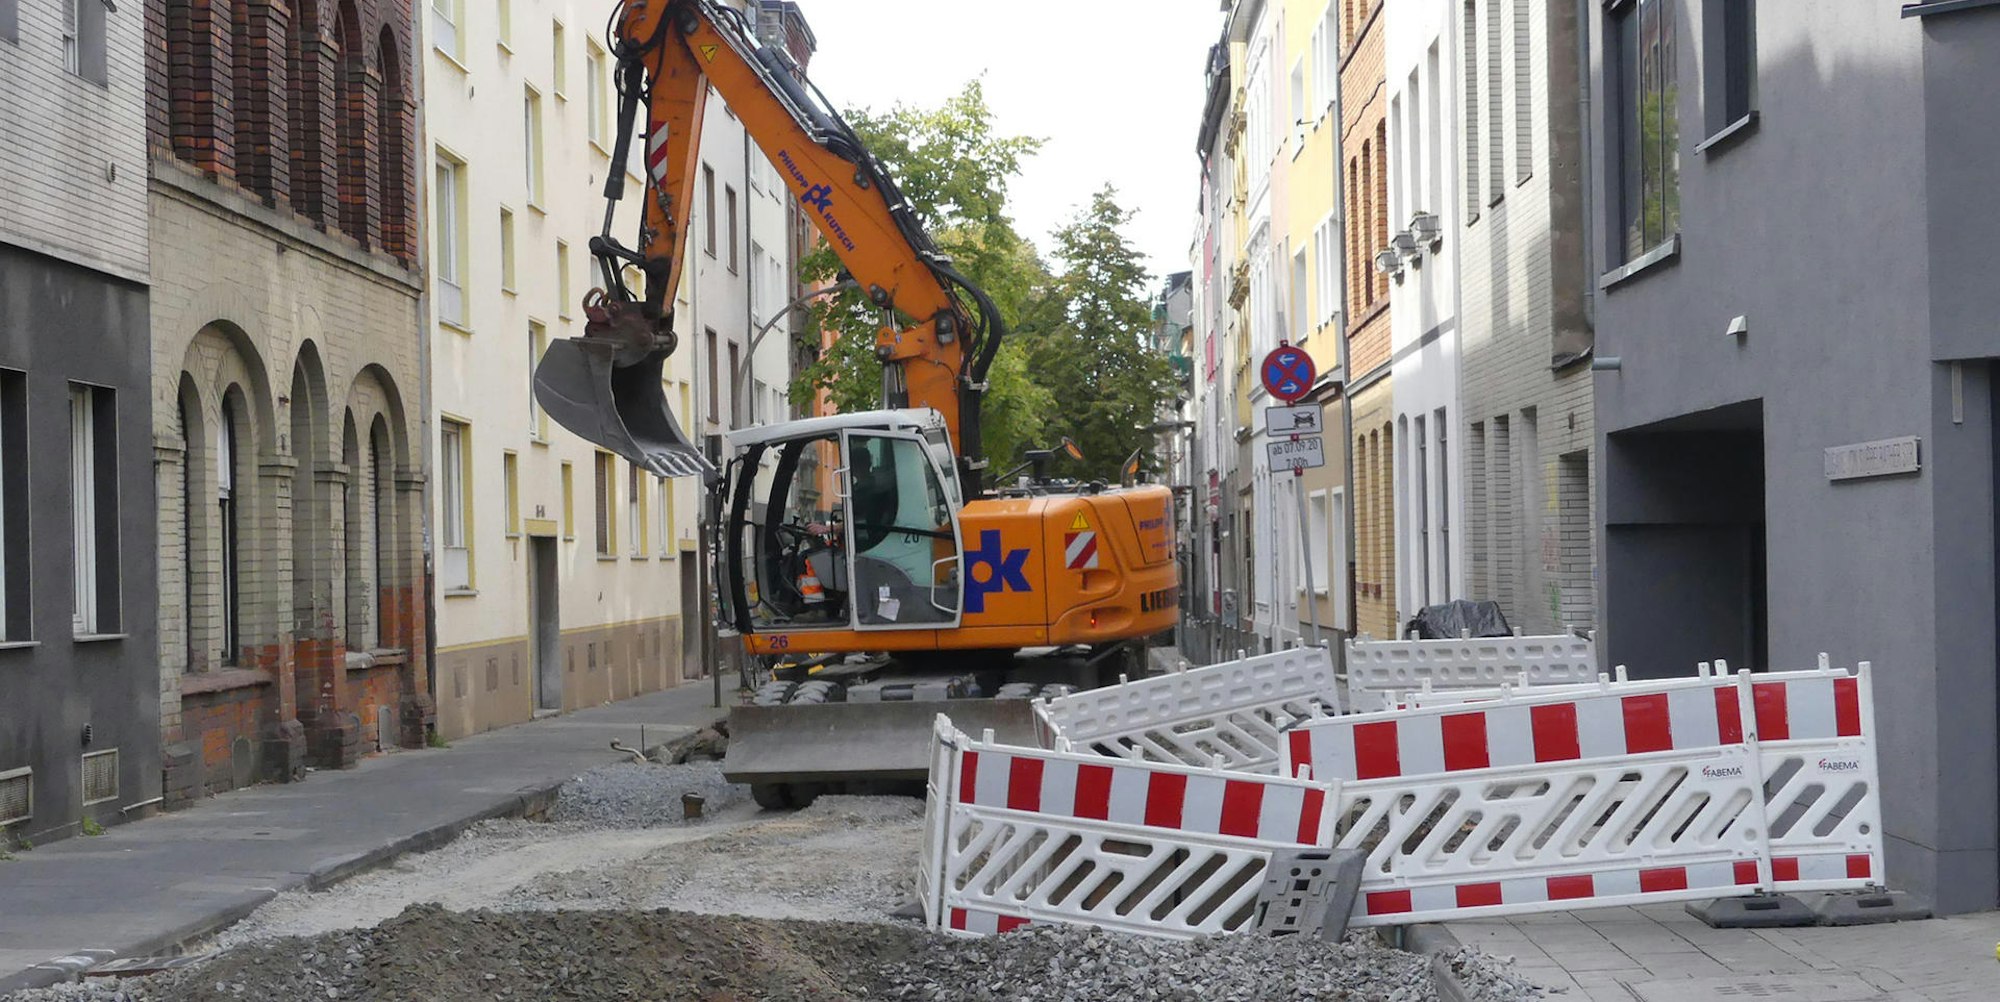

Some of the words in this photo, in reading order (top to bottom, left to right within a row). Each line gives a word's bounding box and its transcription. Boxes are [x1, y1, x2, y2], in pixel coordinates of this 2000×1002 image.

[778, 150, 808, 187] PHILIPP
[824, 212, 854, 252] KUTSCH
[1272, 445, 1283, 455] ab
[964, 529, 1034, 614] pk
[770, 635, 788, 649] 26
[1822, 760, 1859, 771] FABEMA
[1706, 767, 1742, 778] FABEMA
